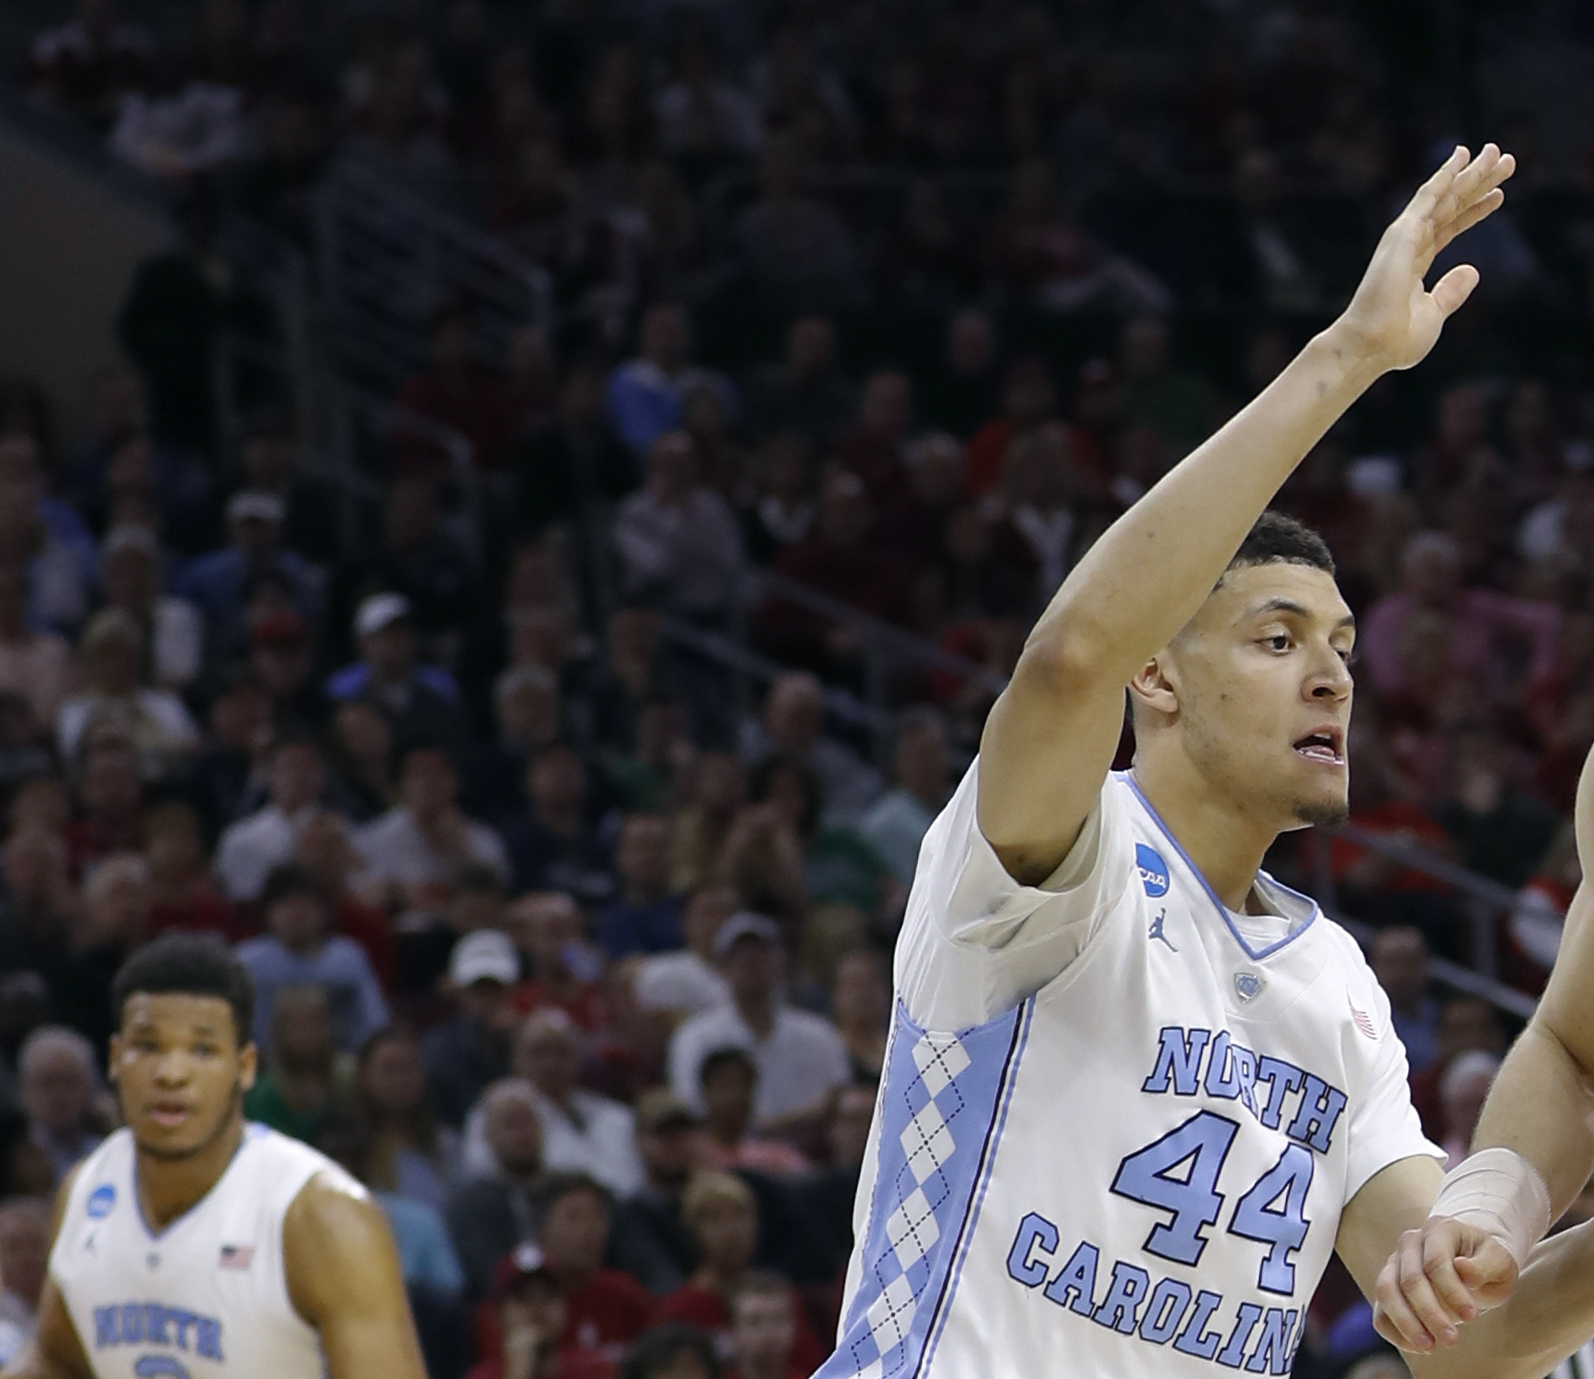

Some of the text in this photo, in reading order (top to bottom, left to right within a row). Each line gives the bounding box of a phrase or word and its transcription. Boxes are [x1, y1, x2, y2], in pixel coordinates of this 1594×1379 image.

[1137, 867, 1167, 888] CAA
[1141, 1026, 1349, 1155] NORTH
[1109, 1108, 1316, 1297] 44
[94, 1302, 223, 1363] NORTH
[1006, 1211, 1306, 1376] CAROLIN
